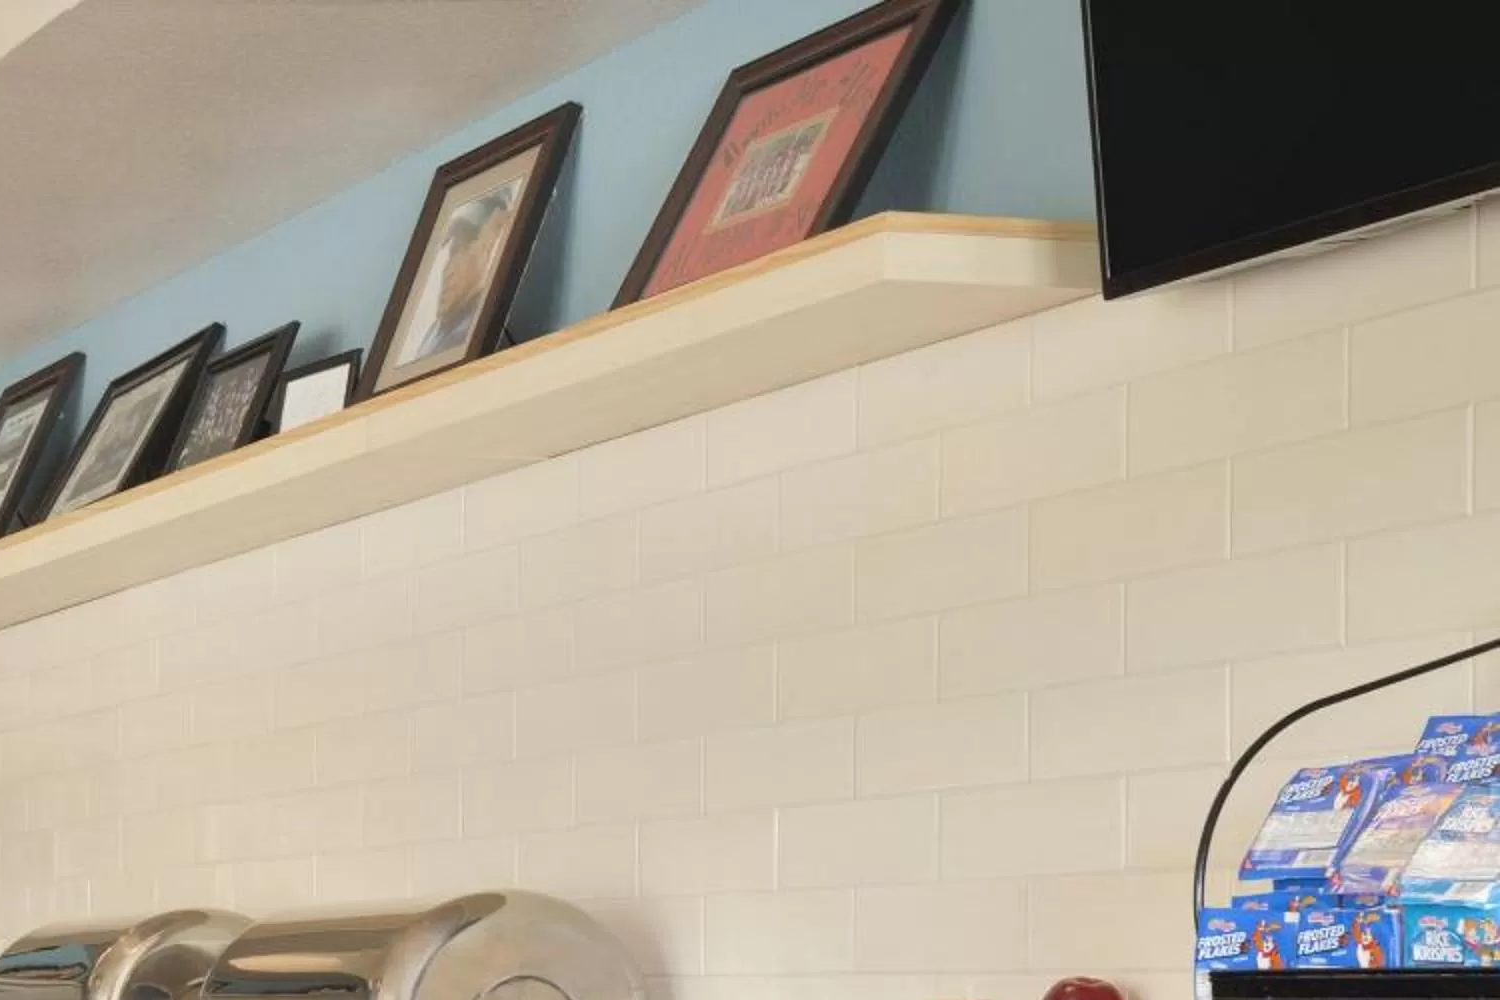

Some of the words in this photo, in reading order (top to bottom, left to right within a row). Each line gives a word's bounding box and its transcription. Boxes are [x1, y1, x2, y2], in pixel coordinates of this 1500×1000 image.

[1199, 932, 1247, 949] FROSTED
[1298, 924, 1345, 943] FROSTED
[1198, 943, 1241, 961] FLAKES
[1298, 936, 1339, 955] FLAKES
